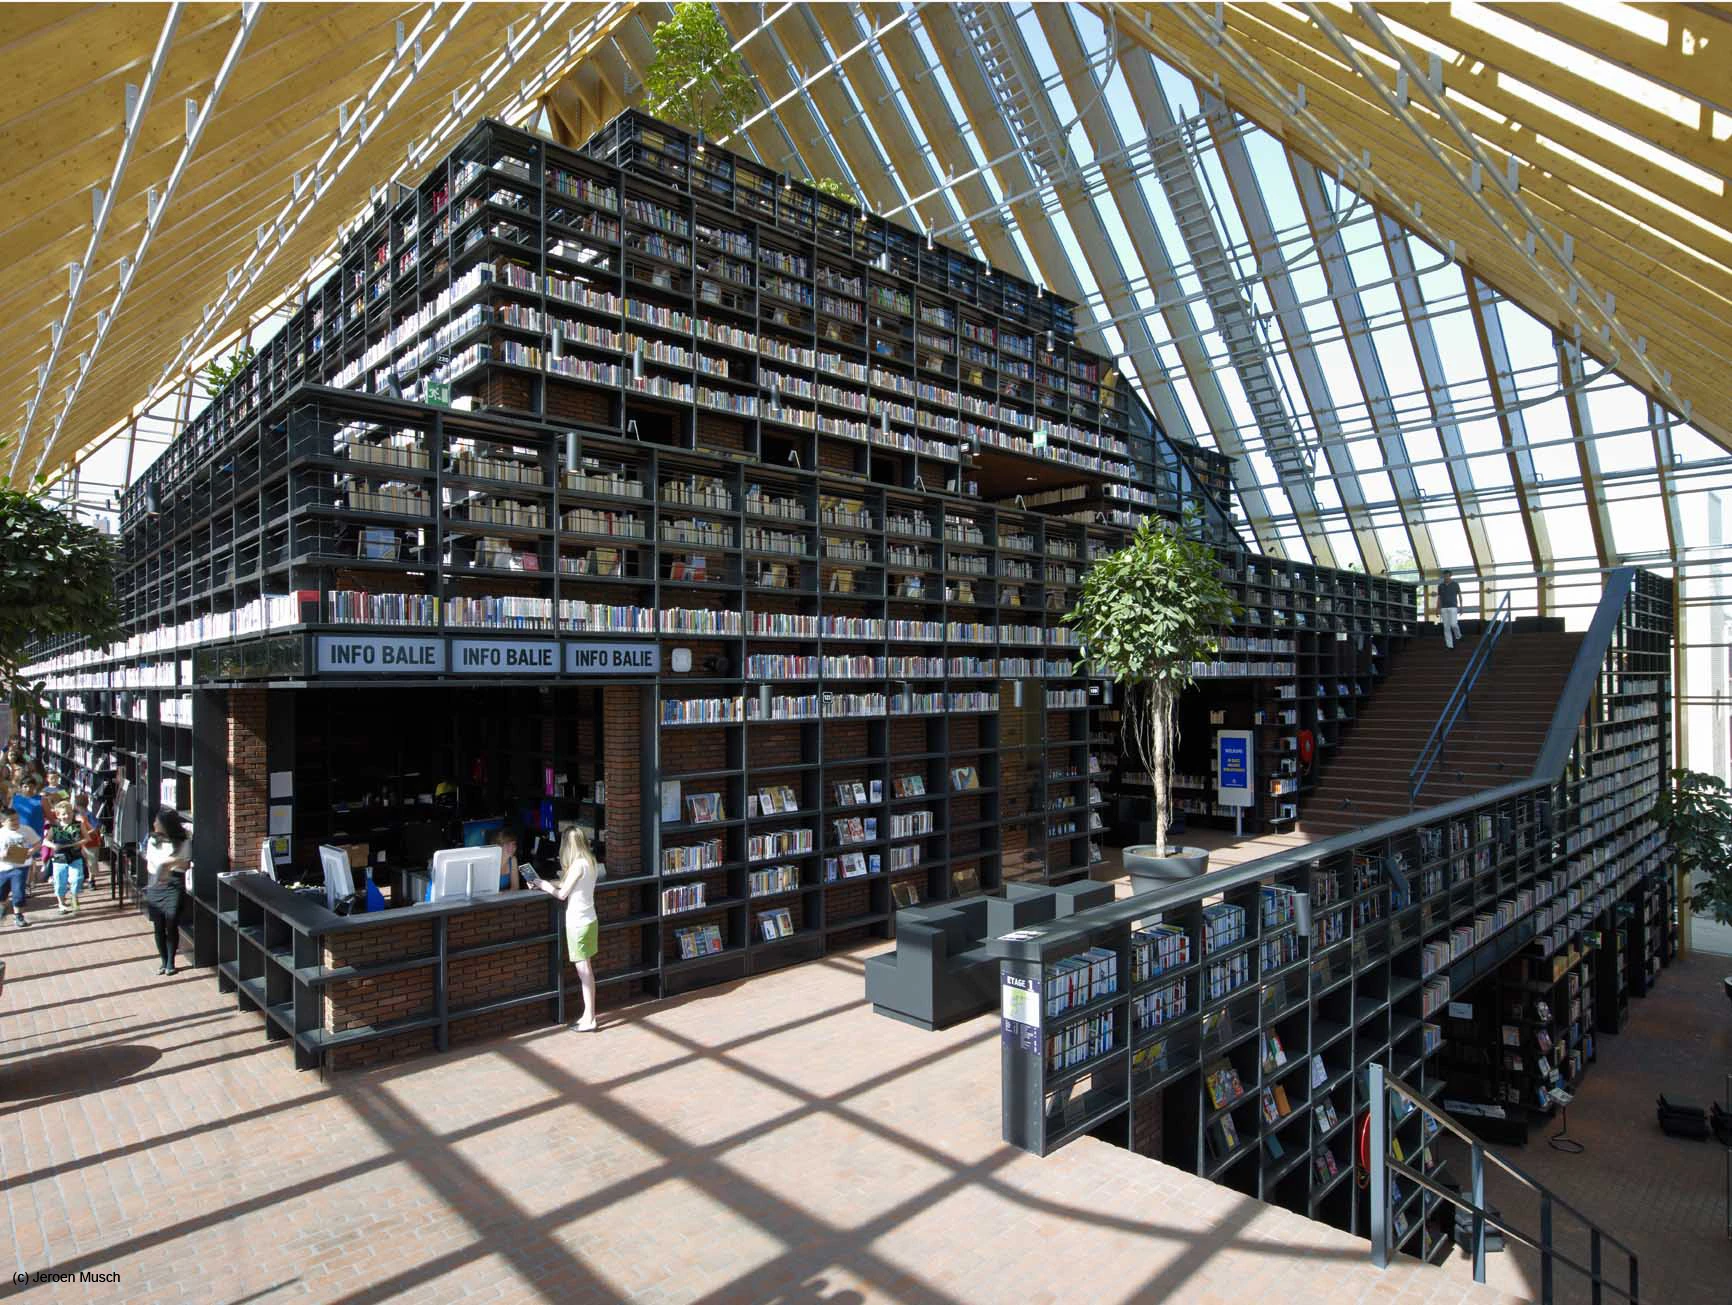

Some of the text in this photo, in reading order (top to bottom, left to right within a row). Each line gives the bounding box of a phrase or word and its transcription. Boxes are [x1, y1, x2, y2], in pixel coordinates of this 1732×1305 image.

[331, 644, 436, 664] INFO BALIE
[463, 647, 552, 666] INFO BALIE
[575, 650, 652, 667] INFO BALIE
